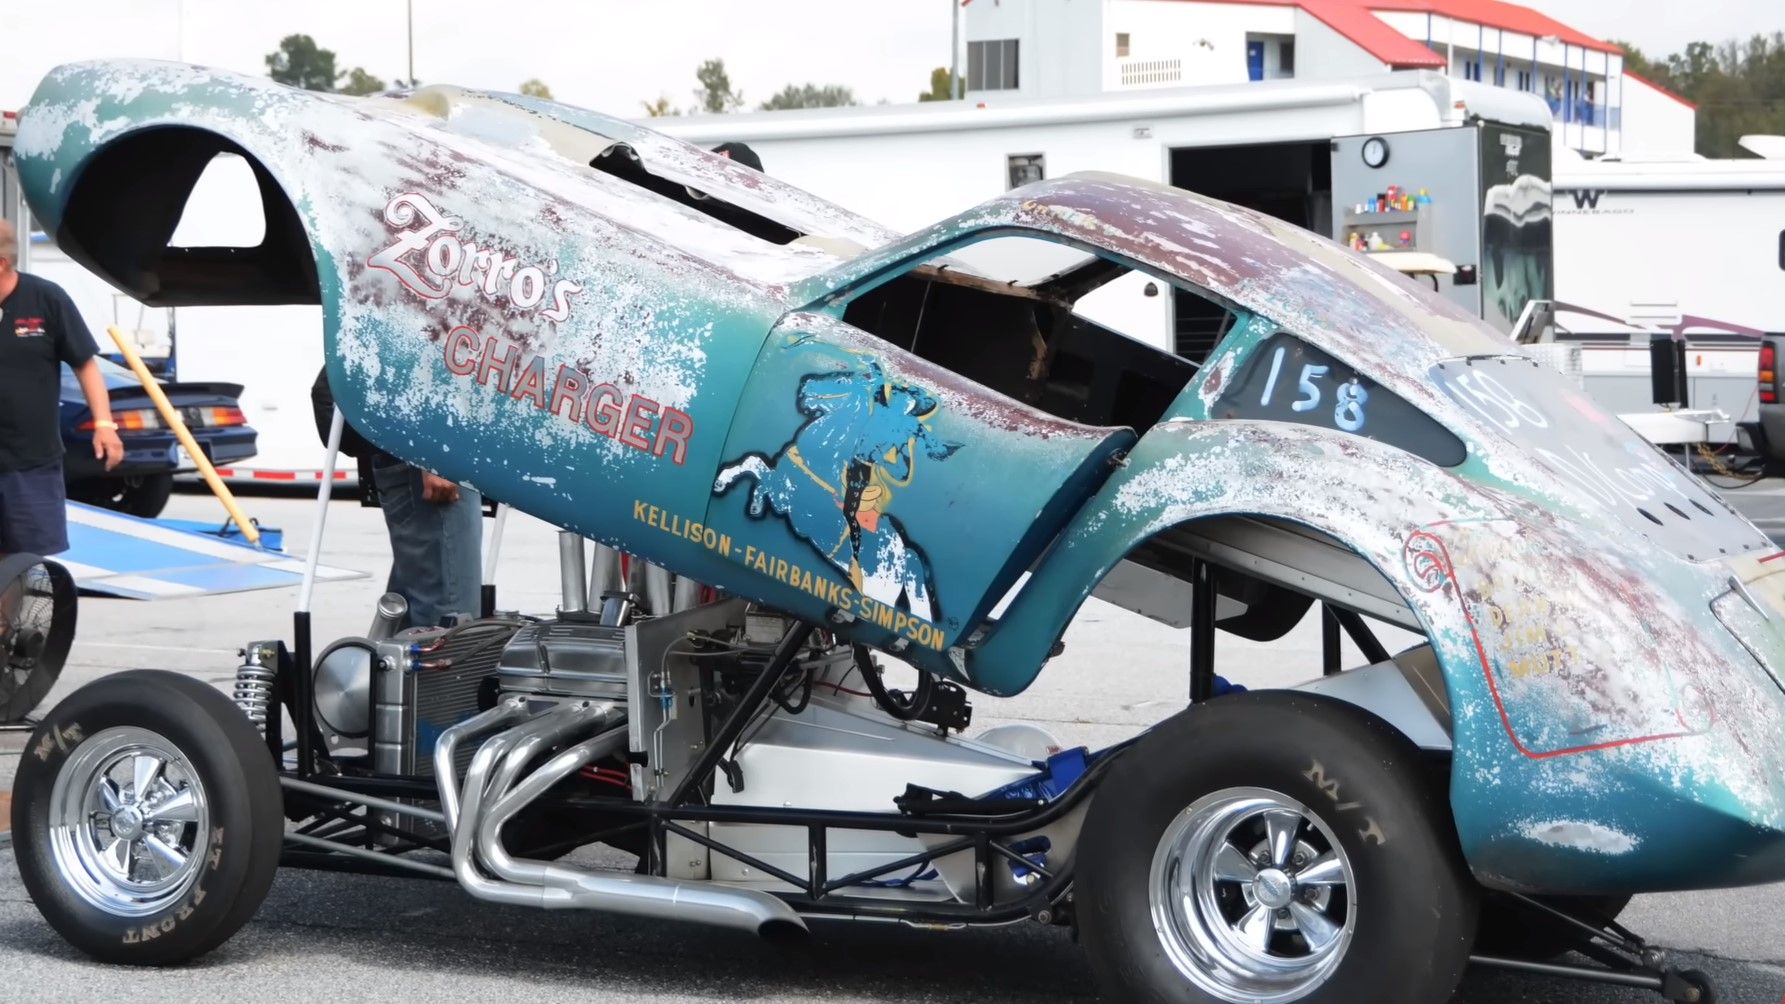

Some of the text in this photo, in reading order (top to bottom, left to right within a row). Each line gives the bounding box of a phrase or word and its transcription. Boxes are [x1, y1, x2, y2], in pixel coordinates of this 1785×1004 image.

[366, 192, 583, 323] Zorro's
[444, 325, 694, 466] CHARGER
[1260, 347, 1369, 431] 158
[1302, 759, 1387, 846] M/T
[121, 884, 208, 944] FRONT
